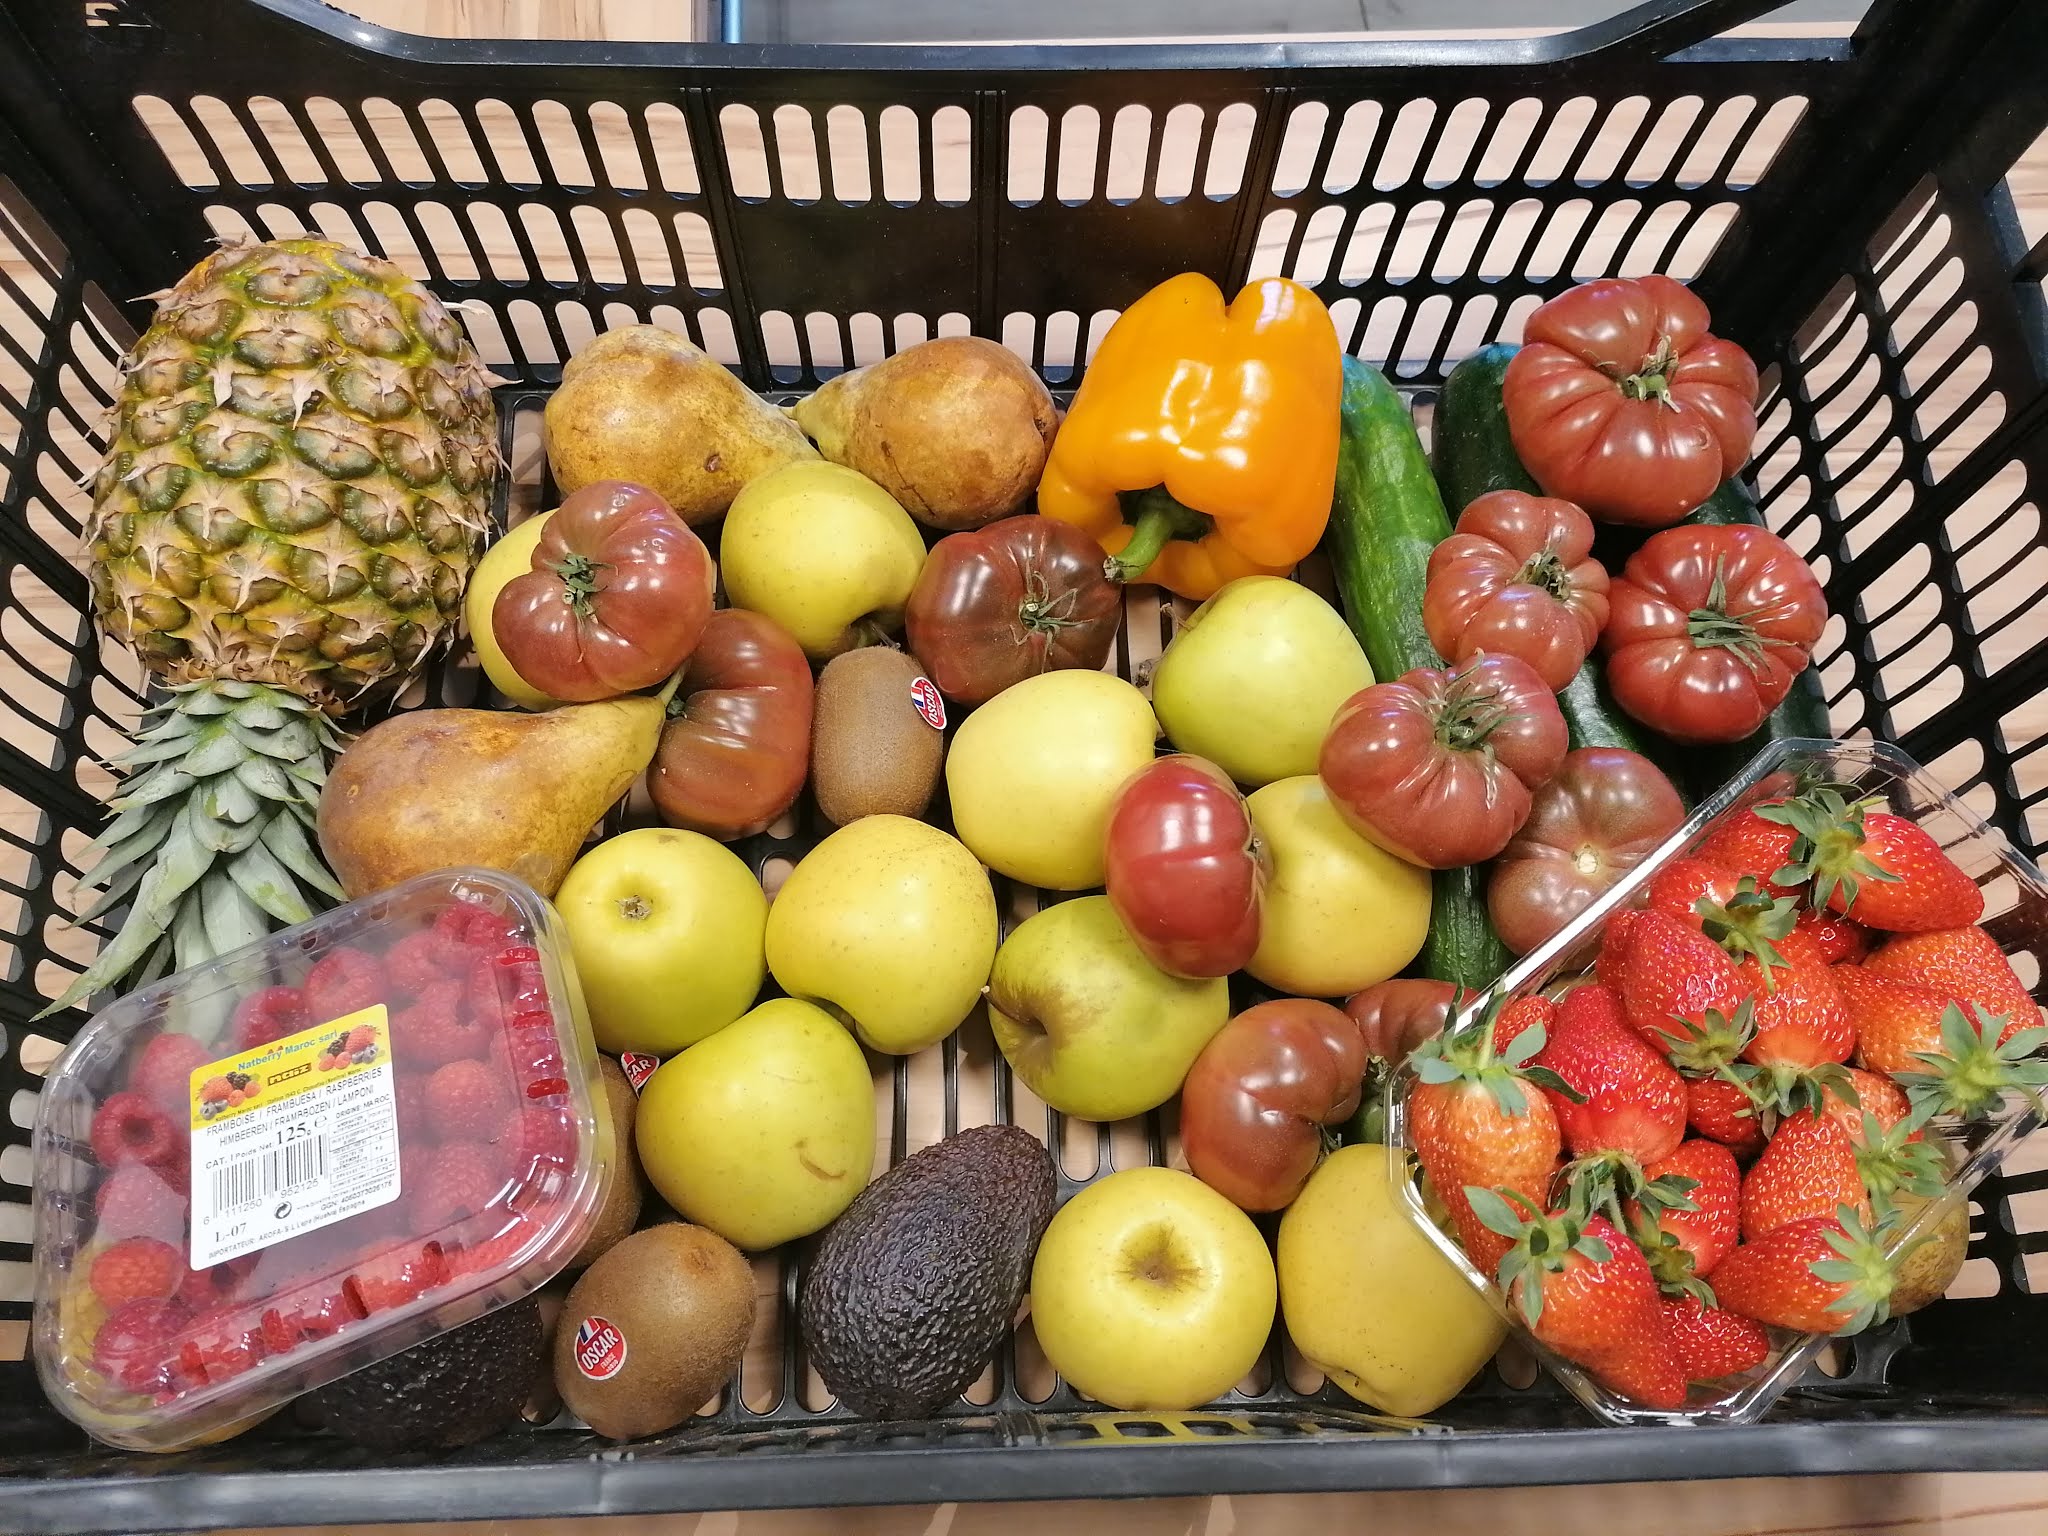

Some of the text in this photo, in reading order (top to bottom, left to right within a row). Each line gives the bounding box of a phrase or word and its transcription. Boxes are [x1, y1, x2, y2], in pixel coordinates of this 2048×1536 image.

[924, 685, 939, 723] OSCAR
[238, 1048, 282, 1073] Natberry
[284, 1036, 315, 1054] Maroc
[206, 1111, 254, 1137] FRAMBOISE
[266, 1089, 316, 1116] FRAMBUESA
[325, 1066, 381, 1095] RASPBERRIES
[219, 1121, 267, 1147] HIMBEEREN
[337, 1084, 373, 1105] LAMPONI
[363, 1092, 389, 1108] MAROC
[205, 1155, 227, 1170] CAT.
[235, 1145, 256, 1160] Poids
[226, 1197, 262, 1218] 111250
[280, 1177, 318, 1199] 952125
[216, 1221, 246, 1242] L-07
[581, 1327, 619, 1370] OSCAR
